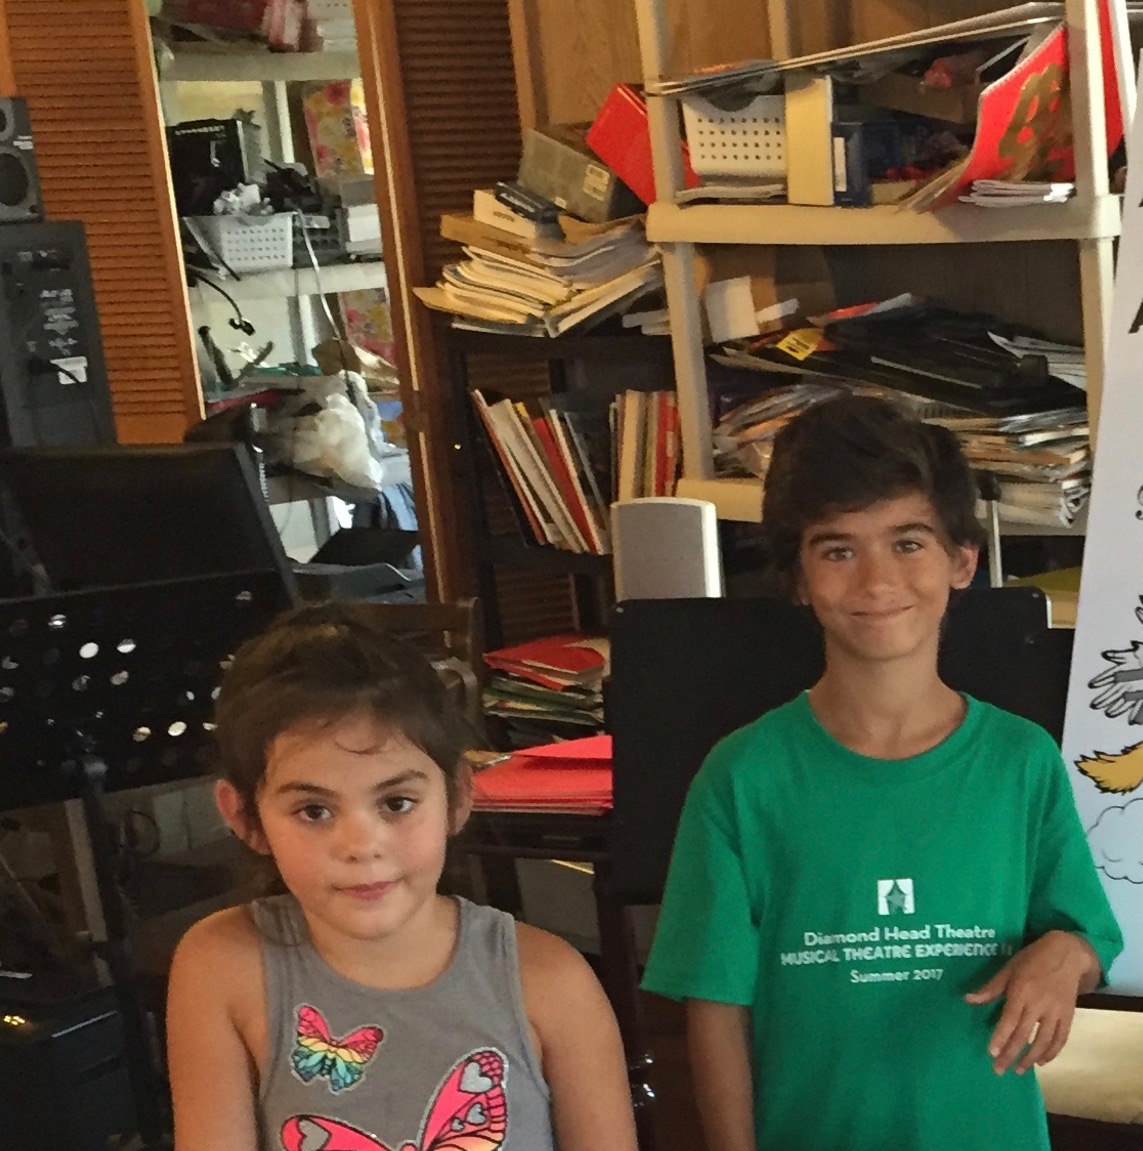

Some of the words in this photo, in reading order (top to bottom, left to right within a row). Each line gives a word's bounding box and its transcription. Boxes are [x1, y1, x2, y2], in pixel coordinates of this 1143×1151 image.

[804, 927, 880, 946] Diamond
[885, 925, 930, 940] Head
[934, 923, 995, 938] Theatre
[780, 947, 839, 966] MUSICAL
[844, 945, 911, 961] THEATRE
[915, 942, 998, 958] EXPERIENCE
[850, 969, 909, 983] Summer
[913, 968, 943, 981] 2017
